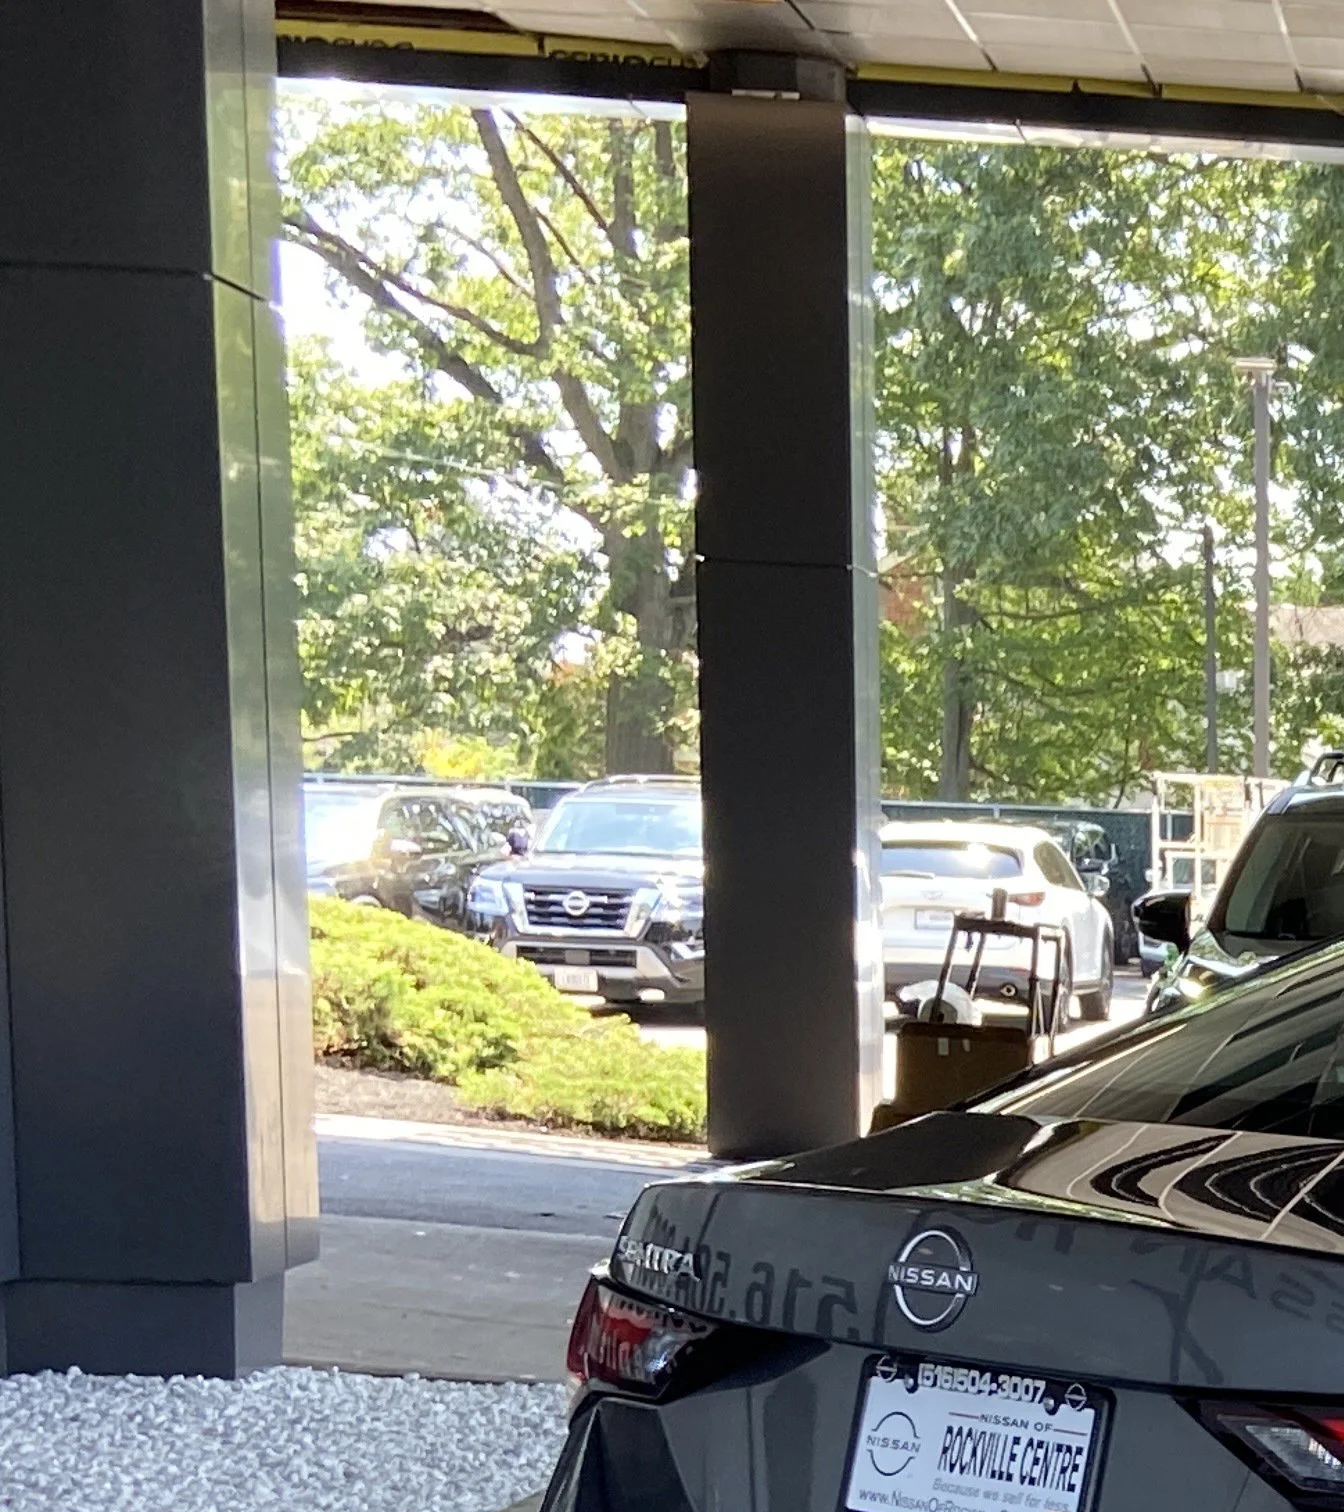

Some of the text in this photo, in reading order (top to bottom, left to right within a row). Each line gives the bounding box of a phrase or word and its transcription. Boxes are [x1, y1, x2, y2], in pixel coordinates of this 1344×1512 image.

[888, 1264, 973, 1291] NISSAN
[979, 1414, 1053, 1432] NISSAN OF
[866, 1435, 921, 1452] NISSAN
[937, 1425, 1084, 1492] ROCKVILLE CENTRE
[932, 1478, 979, 1497] Because
[983, 1490, 999, 1500] we
[1025, 1493, 1040, 1508] for
